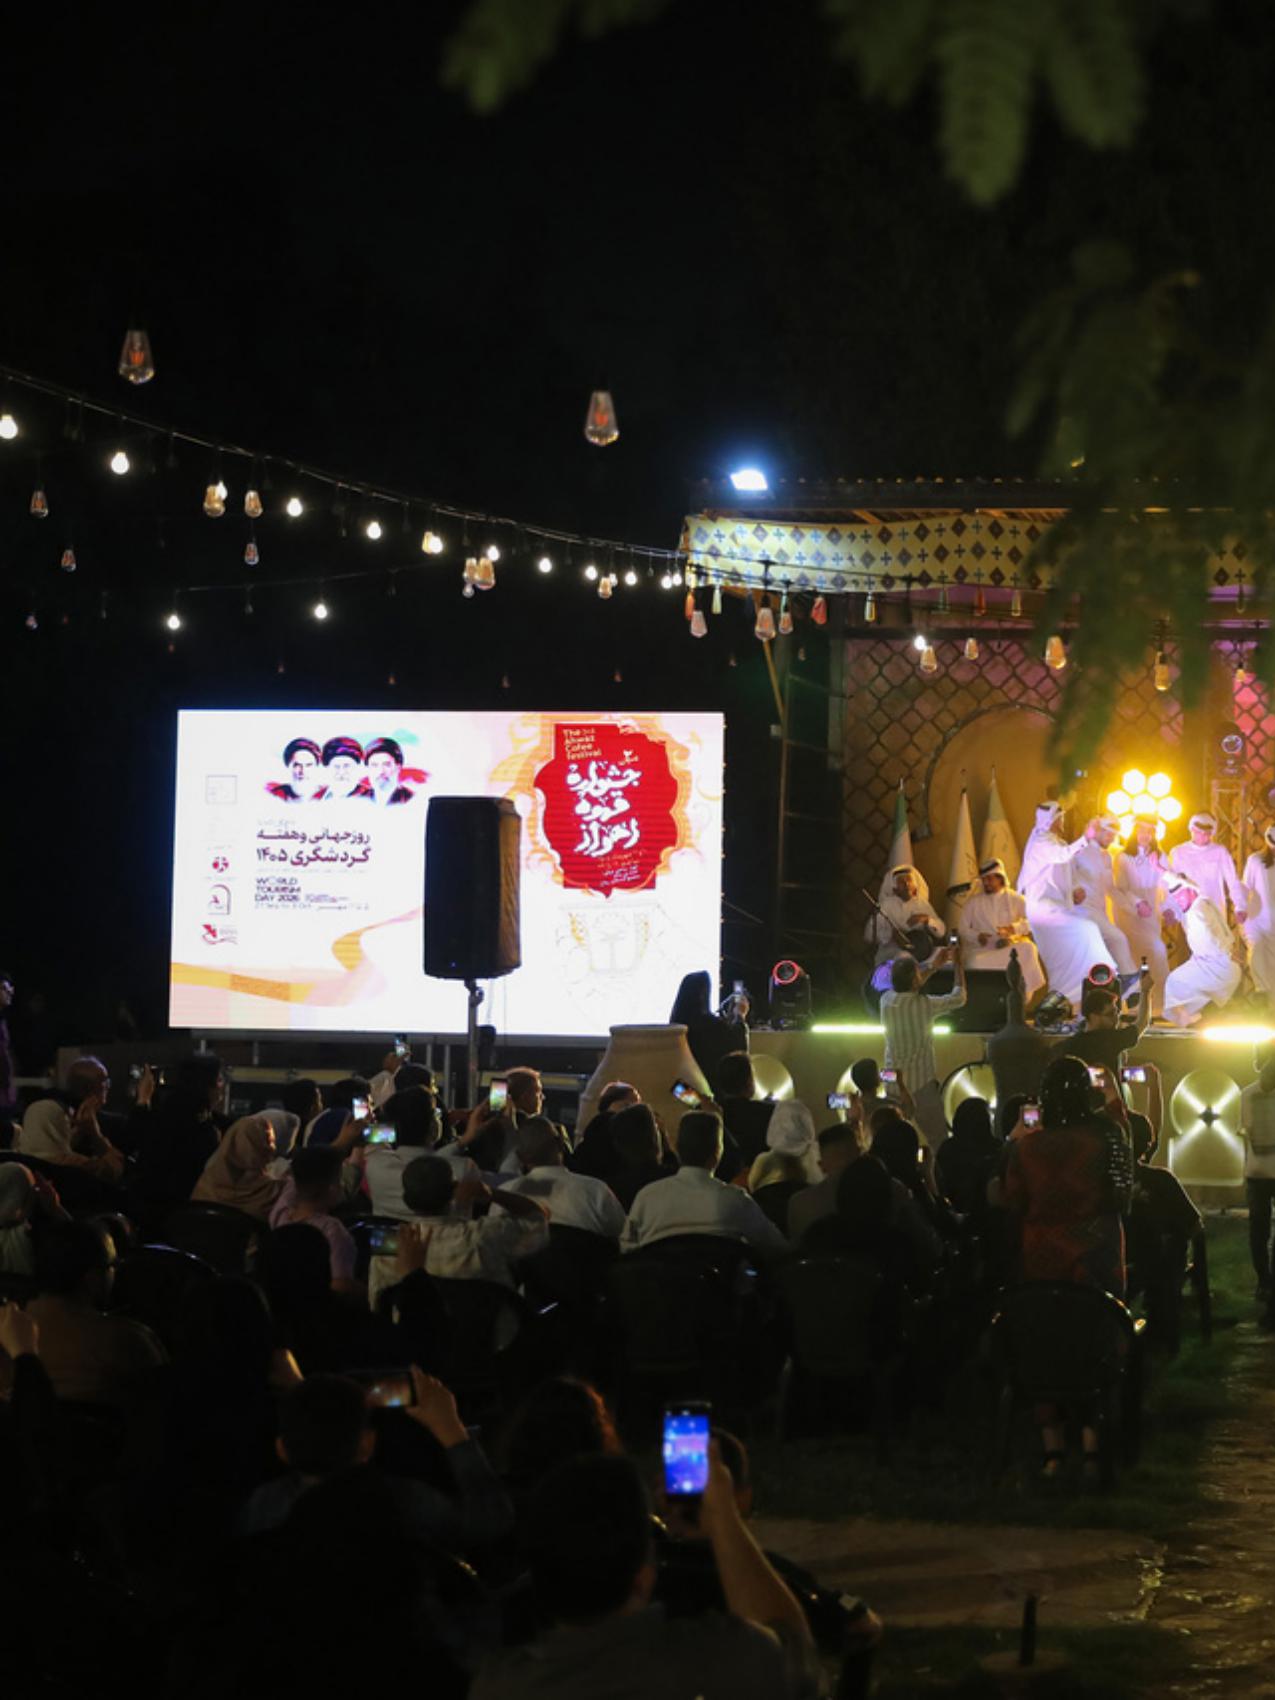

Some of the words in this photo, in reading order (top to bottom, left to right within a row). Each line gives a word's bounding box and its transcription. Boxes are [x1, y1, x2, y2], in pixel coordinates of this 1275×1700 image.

[575, 791, 631, 822] قهوه
[574, 817, 640, 857] اهواز
[290, 846, 371, 867] گردشگری
[256, 876, 298, 885] WORLD
